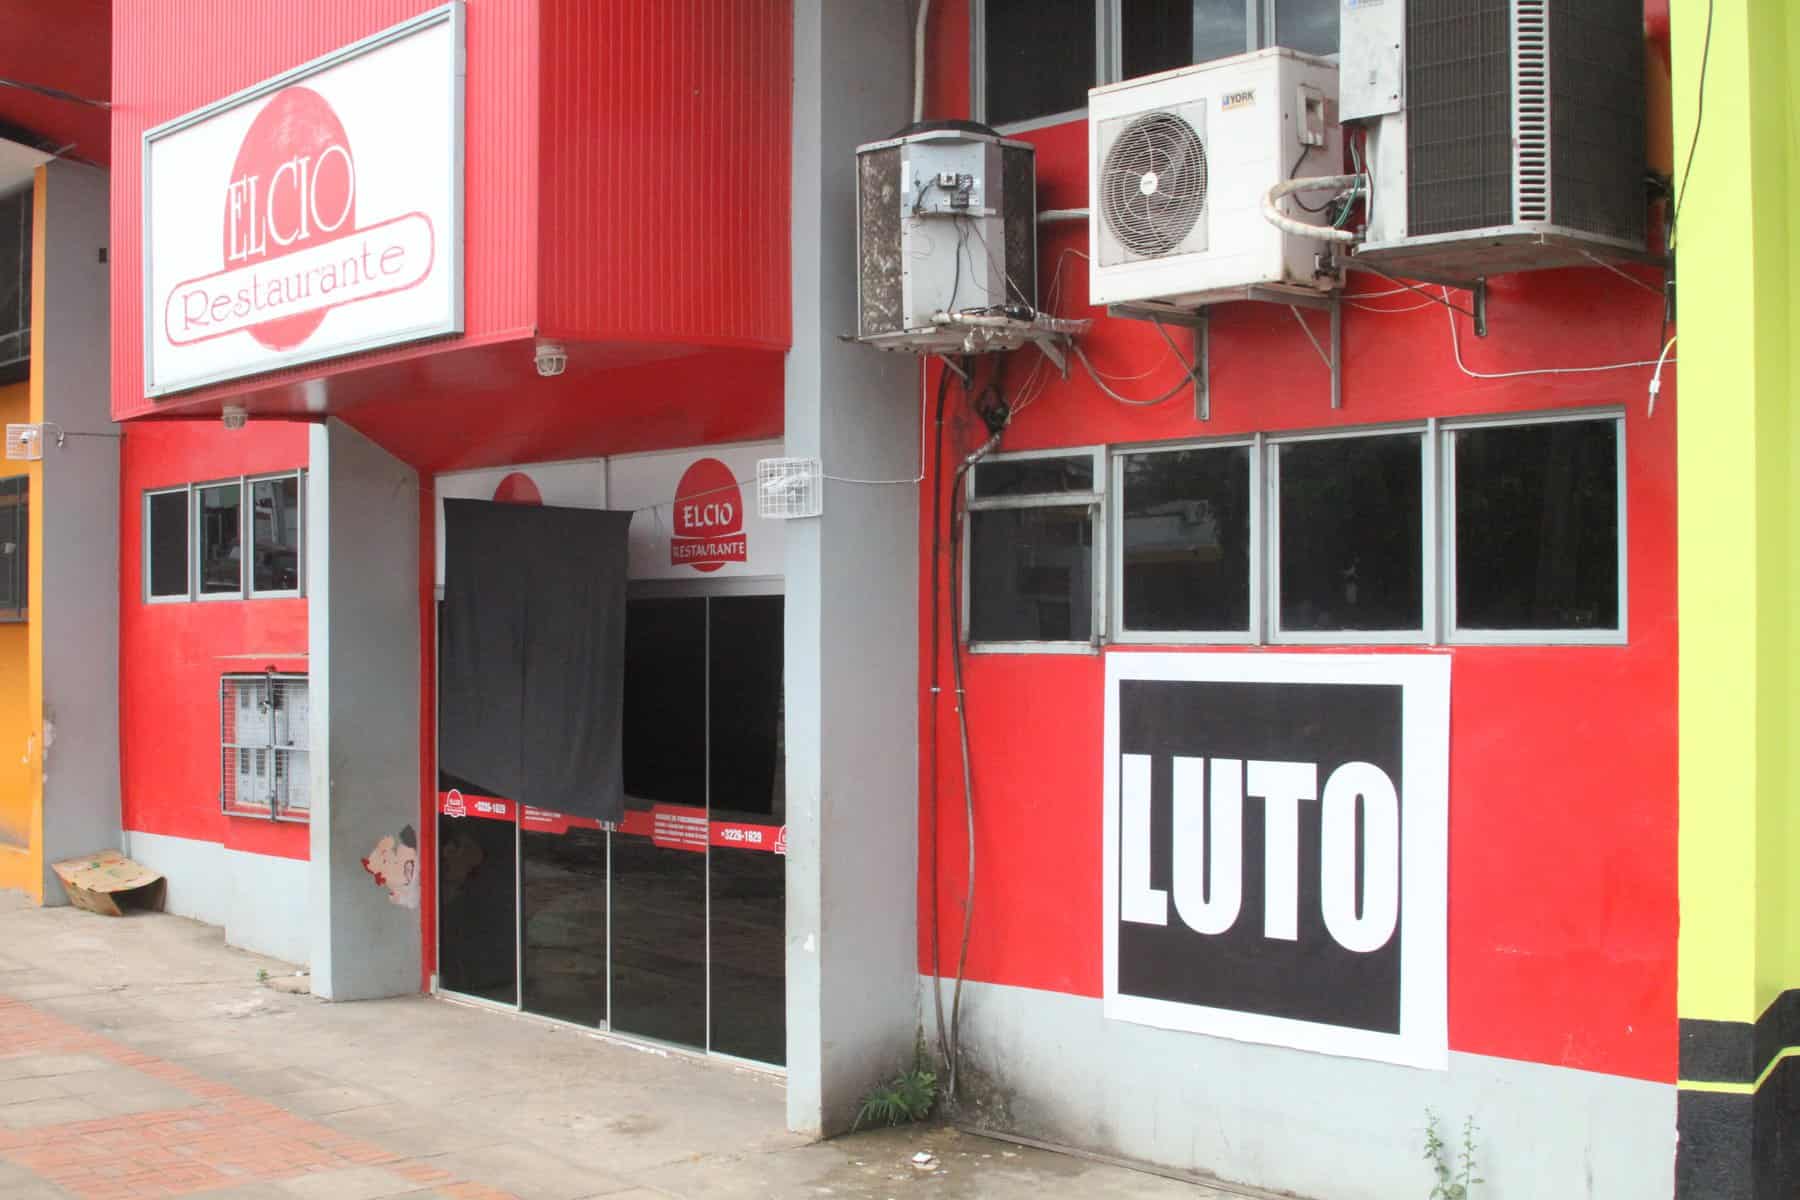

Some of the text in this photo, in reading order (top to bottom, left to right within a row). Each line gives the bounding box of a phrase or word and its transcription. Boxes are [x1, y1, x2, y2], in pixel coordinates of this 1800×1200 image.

[1230, 90, 1257, 105] YORK
[227, 144, 355, 263] ELCIO
[182, 241, 405, 331] Restaurante
[683, 502, 733, 528] ELCIO
[672, 542, 745, 558] RESTAURANTE
[1121, 753, 1399, 953] LUTO
